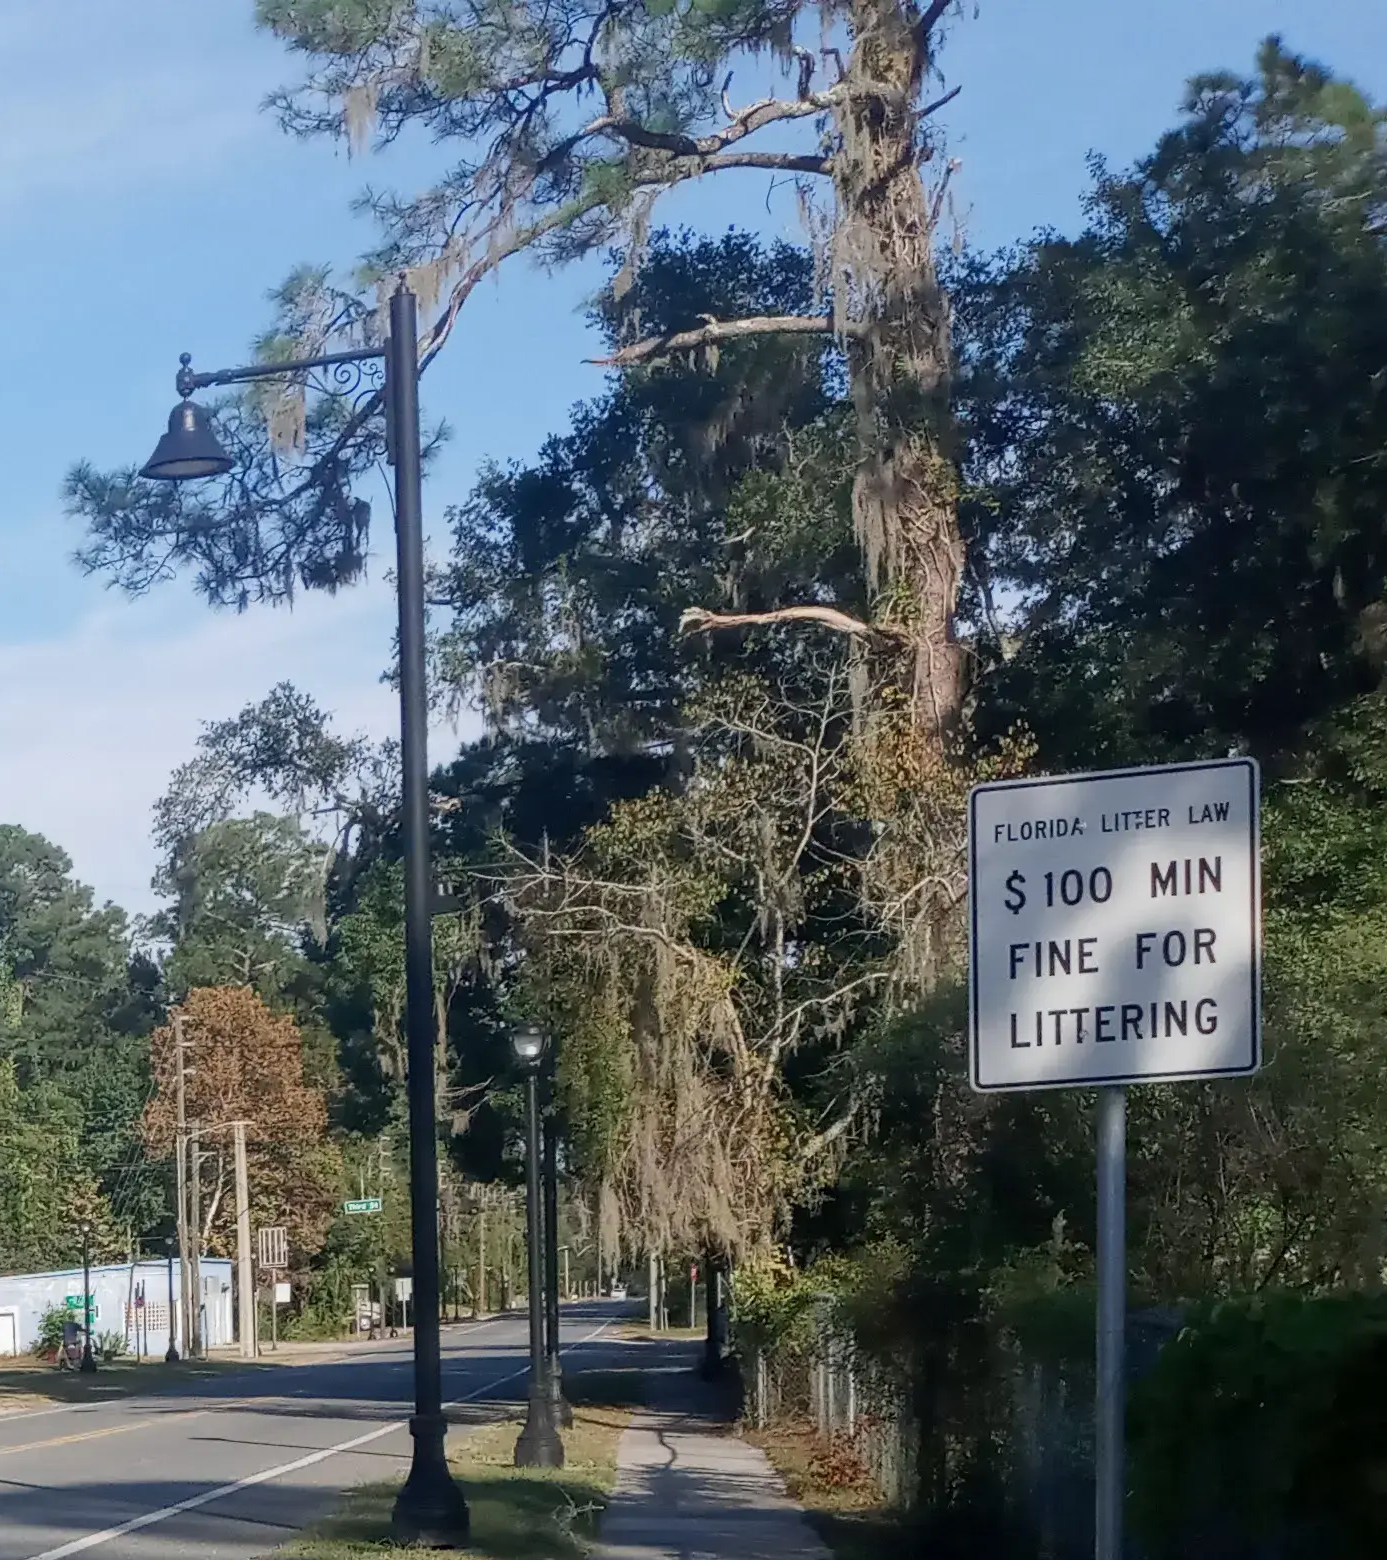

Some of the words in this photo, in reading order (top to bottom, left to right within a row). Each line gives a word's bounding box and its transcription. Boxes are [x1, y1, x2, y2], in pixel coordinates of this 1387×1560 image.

[994, 817, 1084, 844] FLORIDA
[1101, 808, 1170, 833] LITTER
[1188, 801, 1229, 826] LAW
[1004, 866, 1113, 915] $100
[1150, 856, 1222, 899] MIN
[1009, 937, 1099, 980] FINE
[1135, 928, 1217, 970] FOR
[1010, 998, 1218, 1049] LITTERING
